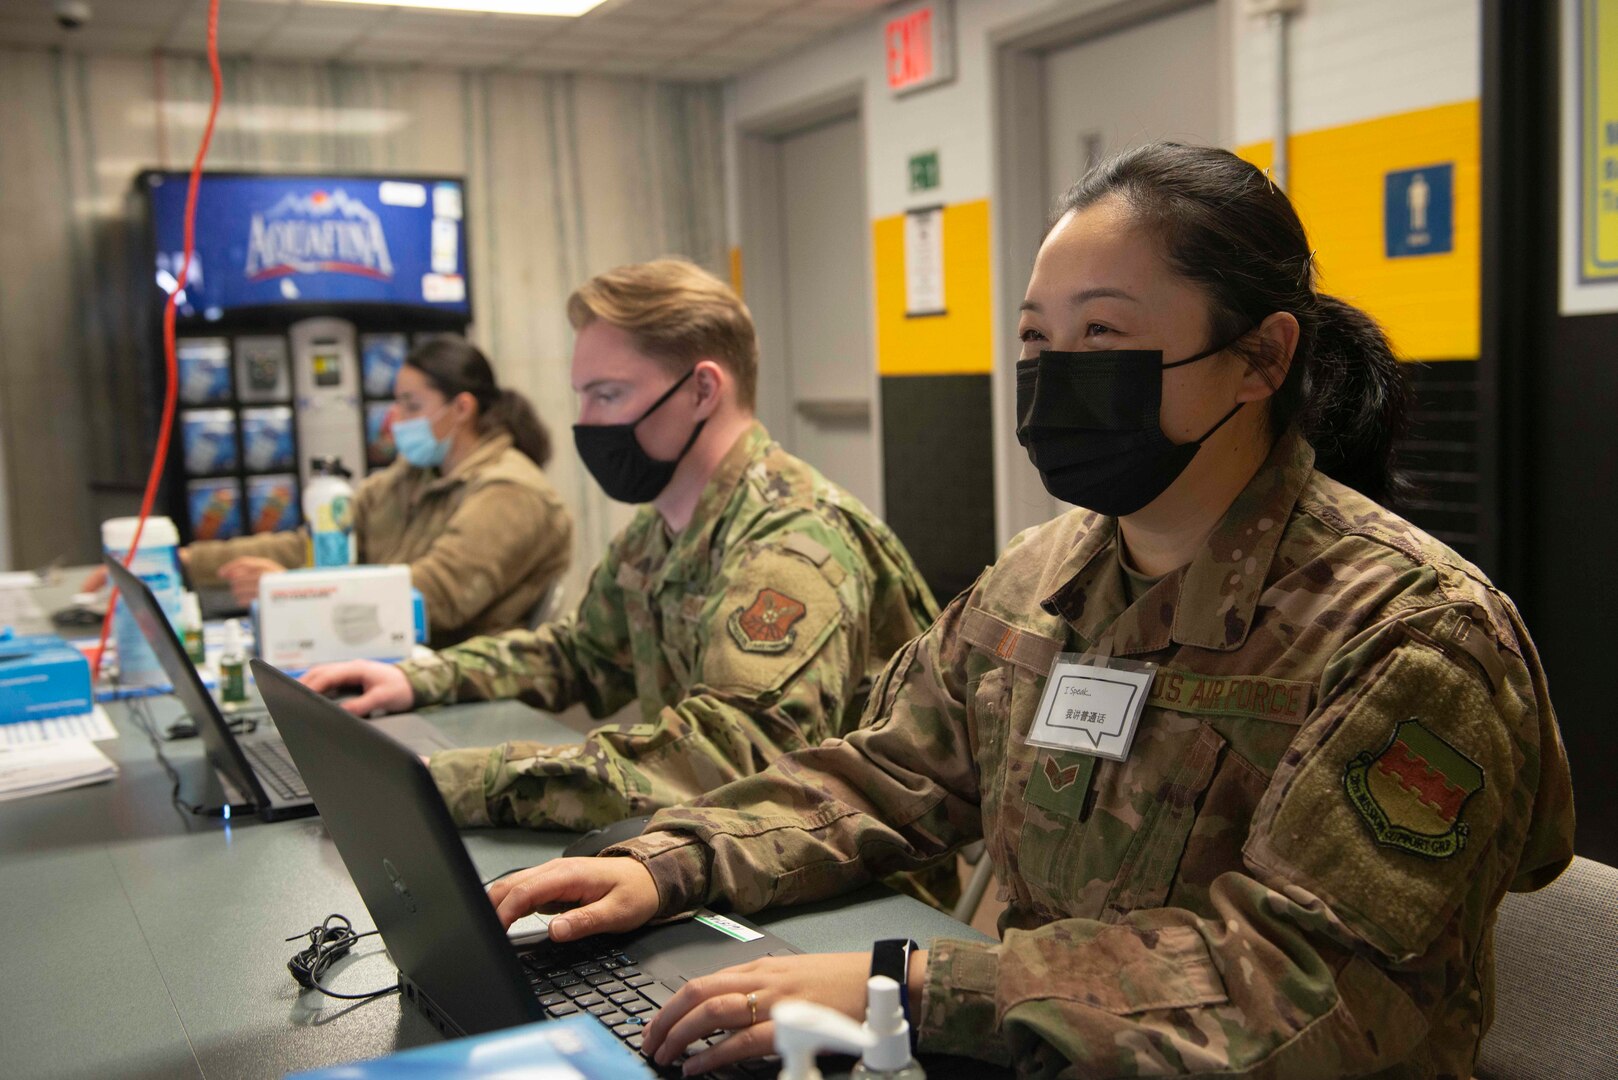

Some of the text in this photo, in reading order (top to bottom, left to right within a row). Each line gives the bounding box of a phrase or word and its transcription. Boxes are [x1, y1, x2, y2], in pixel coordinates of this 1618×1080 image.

[887, 9, 931, 87] EXIT
[1064, 686, 1070, 695] I
[1188, 679, 1224, 709] AIR
[1224, 680, 1301, 716] FORCE
[1065, 708, 1106, 724] 我讲普通话
[1358, 794, 1387, 832] MISSION
[1385, 830, 1431, 850] SUPPORT
